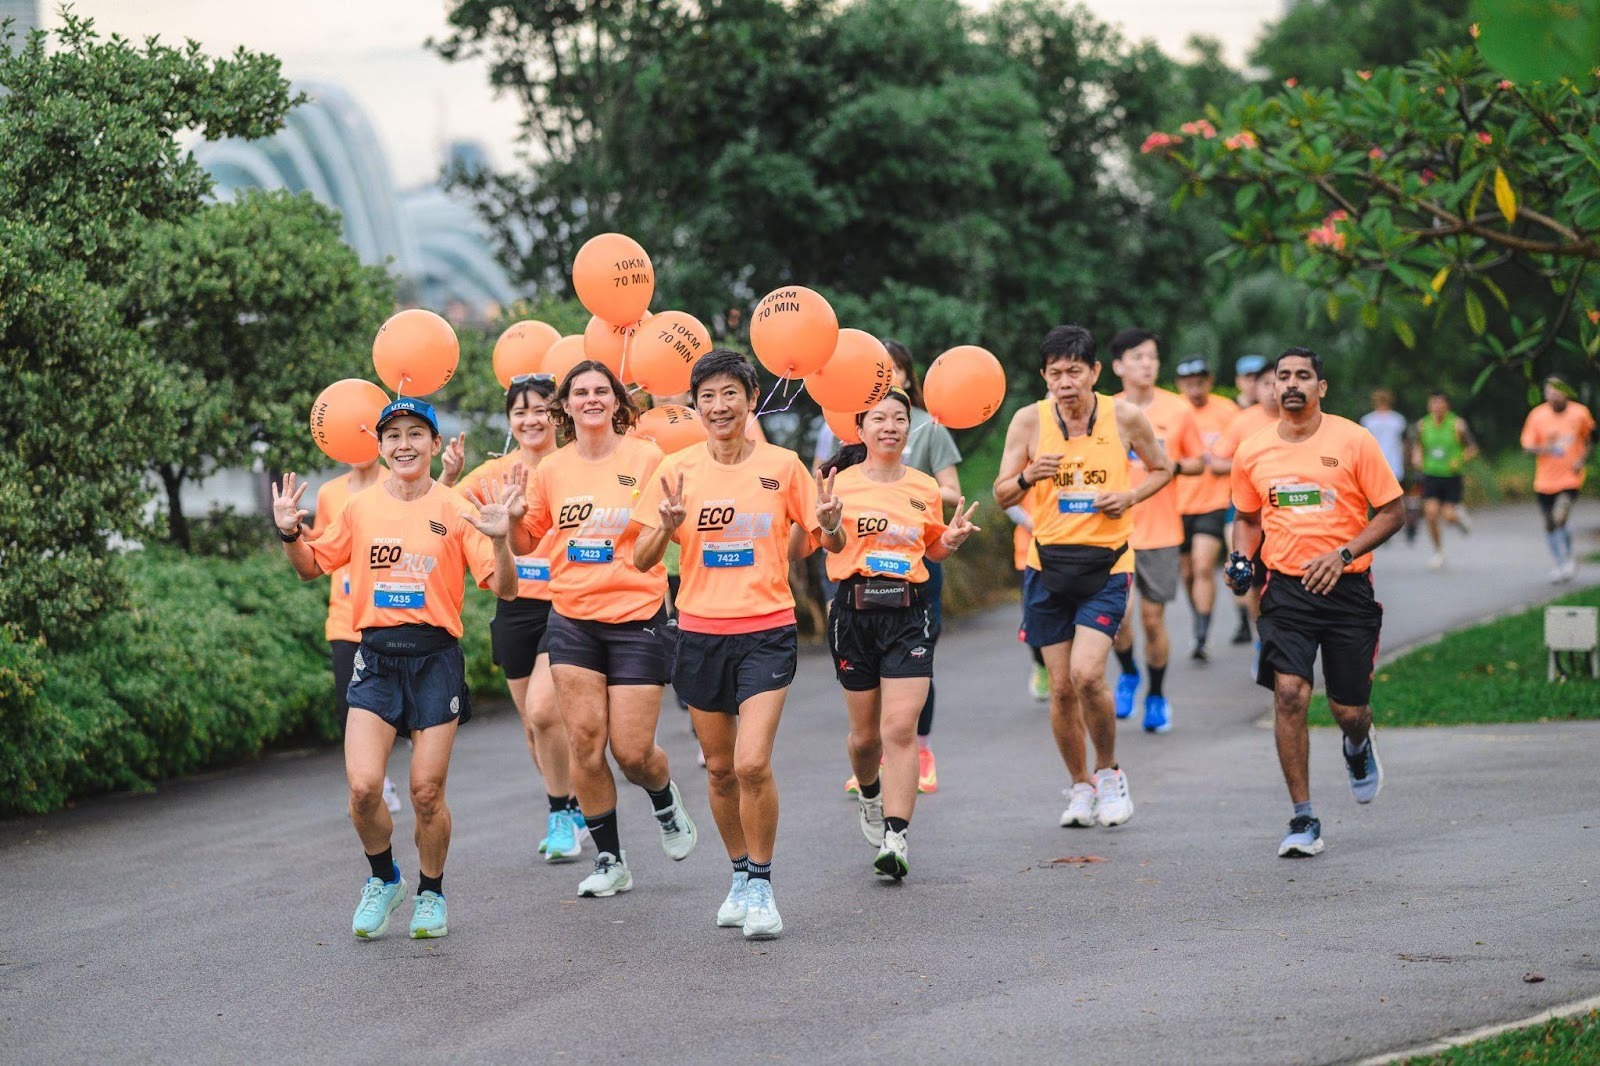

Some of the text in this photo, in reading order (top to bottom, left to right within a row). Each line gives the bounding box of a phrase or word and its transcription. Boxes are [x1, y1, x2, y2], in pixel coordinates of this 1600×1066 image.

[614, 258, 646, 271] 10KM
[614, 273, 650, 288] 70 MIN
[762, 291, 797, 306] 10KM
[758, 302, 800, 322] 70 MIN
[672, 322, 701, 350] 10KM
[658, 330, 694, 364] 70 MIN
[864, 362, 884, 405] 70 MIN
[391, 402, 415, 411] UTMB
[317, 403, 328, 446] 70 MIN
[1084, 470, 1107, 484] 350
[1288, 494, 1308, 502] 8339
[559, 503, 594, 525] ECO
[698, 506, 735, 526] ECO
[858, 518, 888, 533] ECO
[370, 546, 402, 564] ECO
[580, 550, 600, 558] 7423
[718, 554, 740, 562] 7422
[878, 560, 899, 569] 7430
[388, 594, 411, 604] 7435
